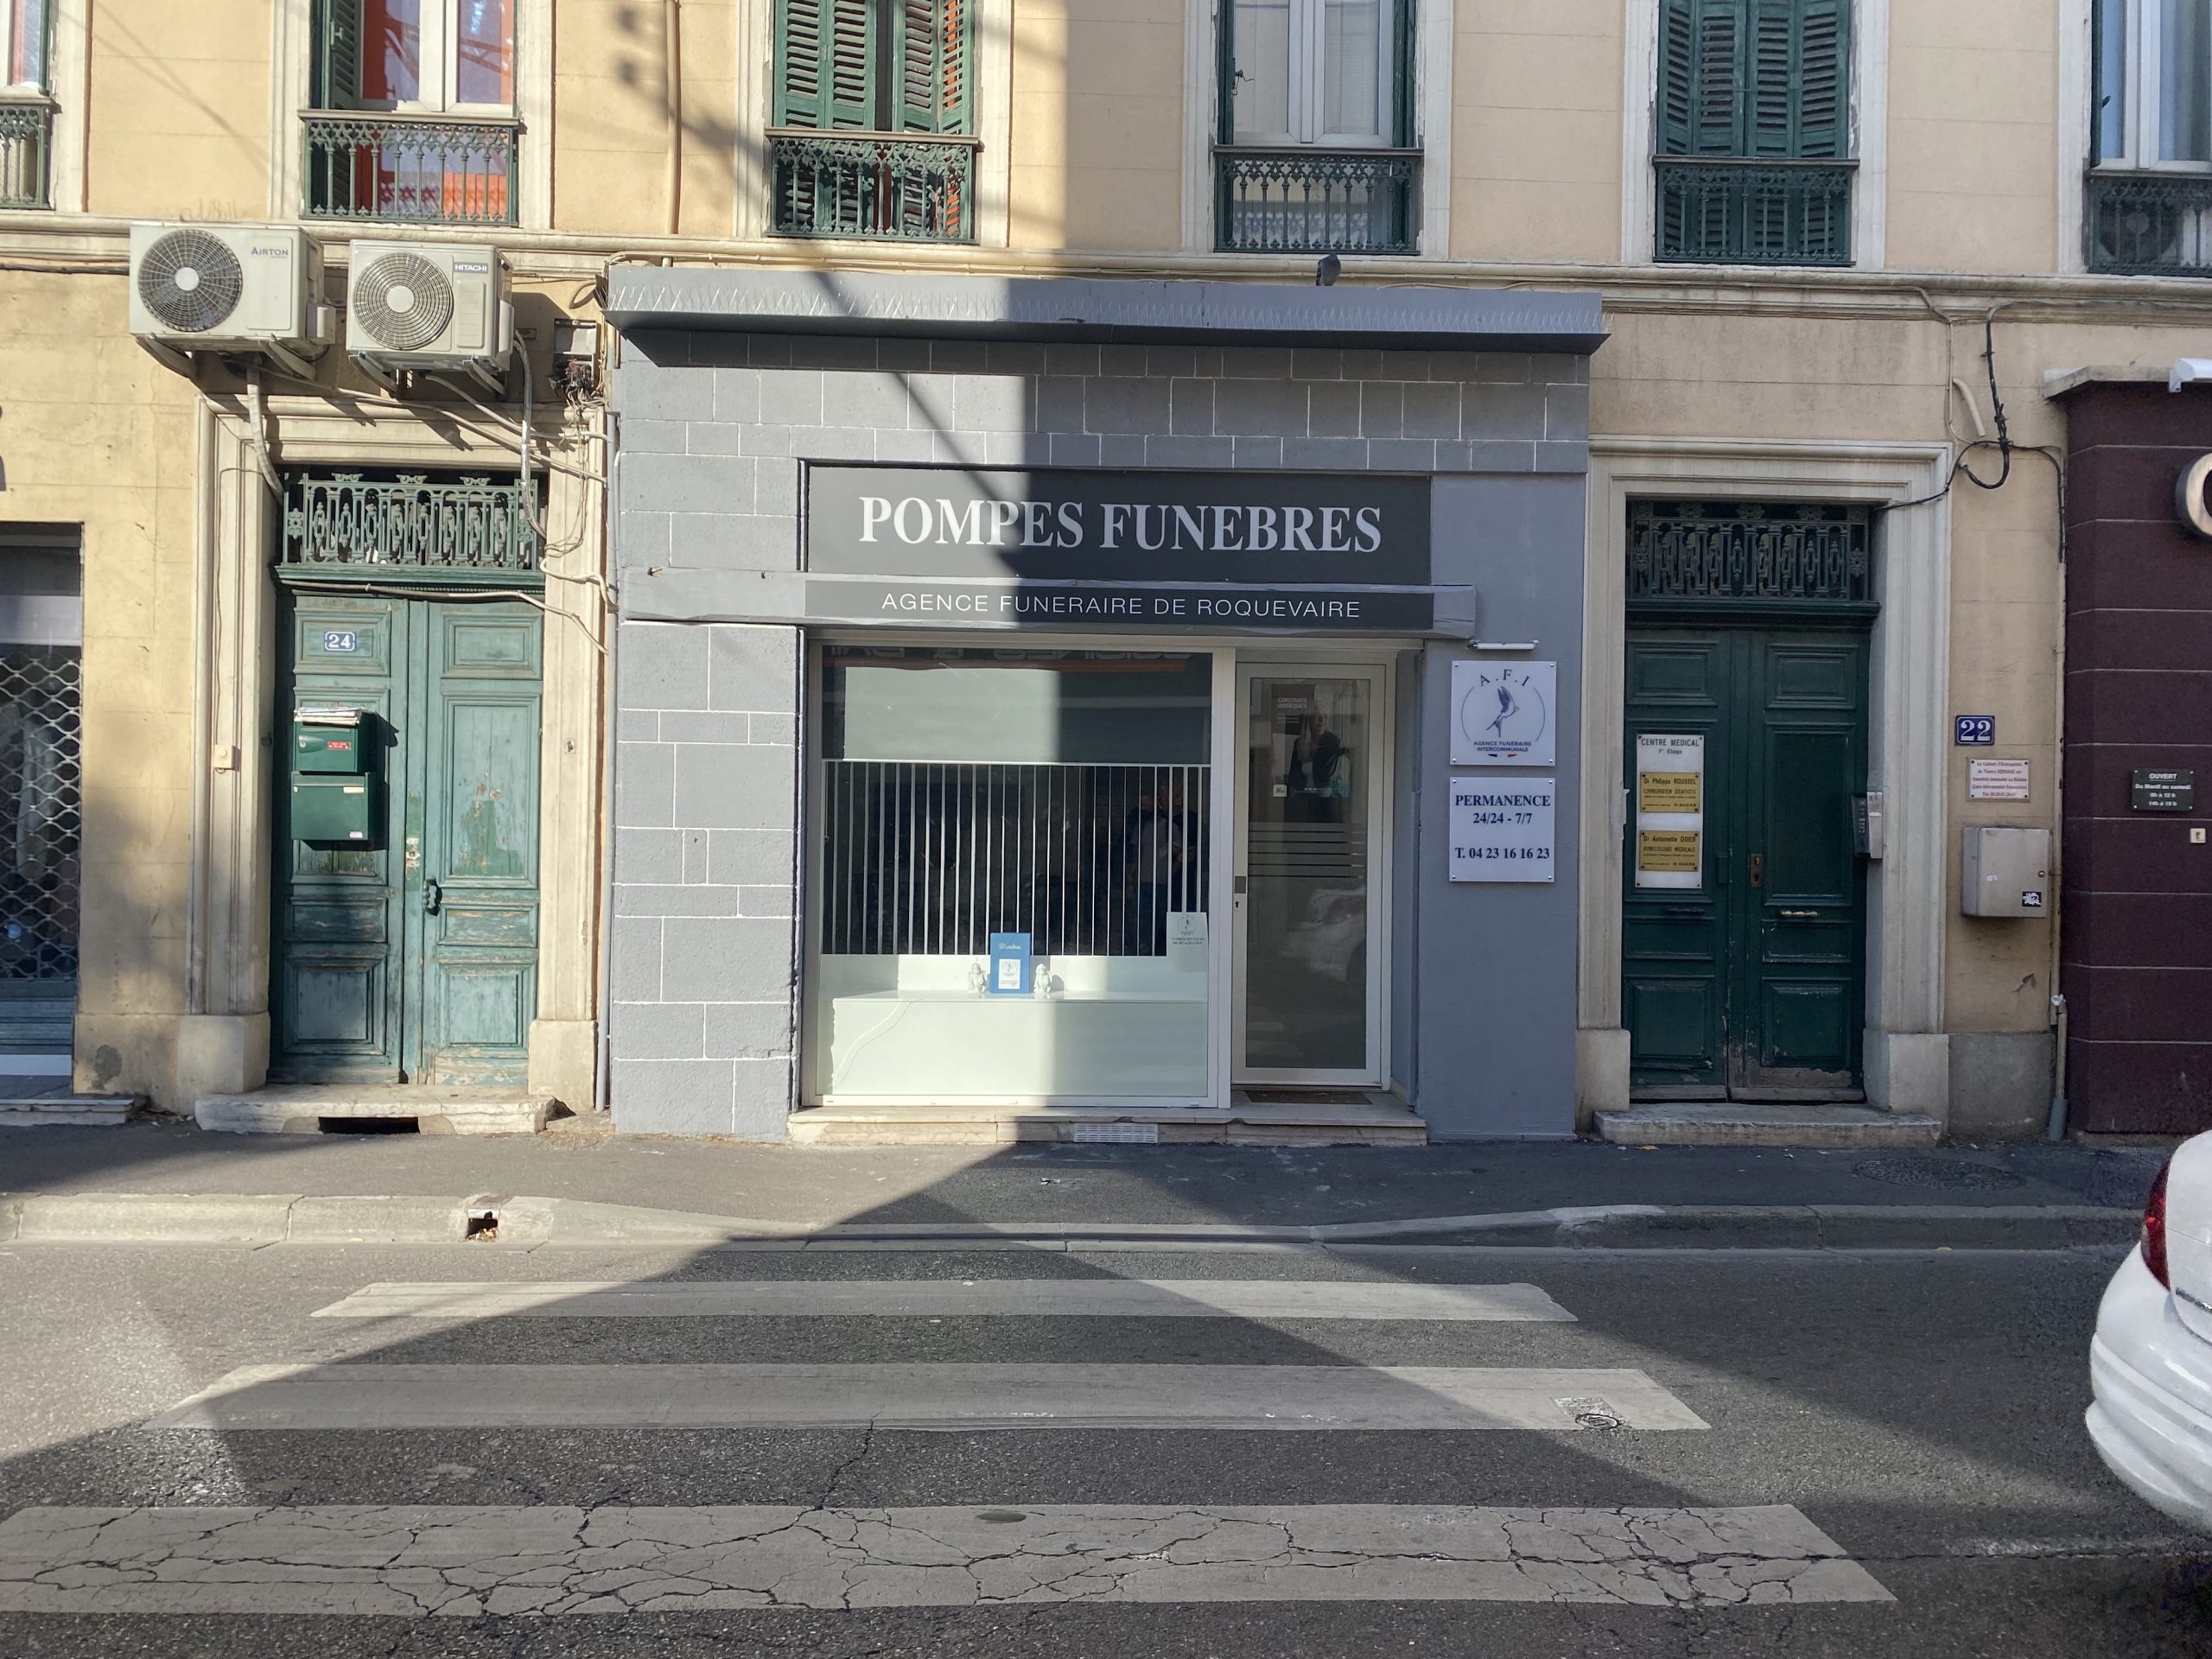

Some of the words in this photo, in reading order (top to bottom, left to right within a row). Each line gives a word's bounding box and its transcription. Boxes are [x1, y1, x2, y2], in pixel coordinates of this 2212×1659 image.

[454, 264, 487, 272] HITACHI
[858, 496, 1084, 549] POMPES
[1099, 503, 1382, 553] FUNEBRES
[881, 593, 988, 612] AGENCE
[1001, 595, 1142, 614] FUNERAIRE
[1154, 598, 1185, 615] DE
[1198, 599, 1360, 618] ROQUEVAIRE
[327, 633, 352, 649] 24
[1961, 720, 1991, 741] 22
[1641, 738, 1667, 747] CENTRE
[1455, 794, 1551, 807] PERMANENCE
[1472, 812, 1504, 824] 24/24
[1515, 812, 1533, 824] 7/7
[1455, 847, 1465, 859] T.
[1469, 848, 1483, 859] 04
[1485, 848, 1499, 859] 23
[1503, 848, 1516, 859] 16
[1520, 848, 1534, 859] 16
[1536, 848, 1550, 859] 23
